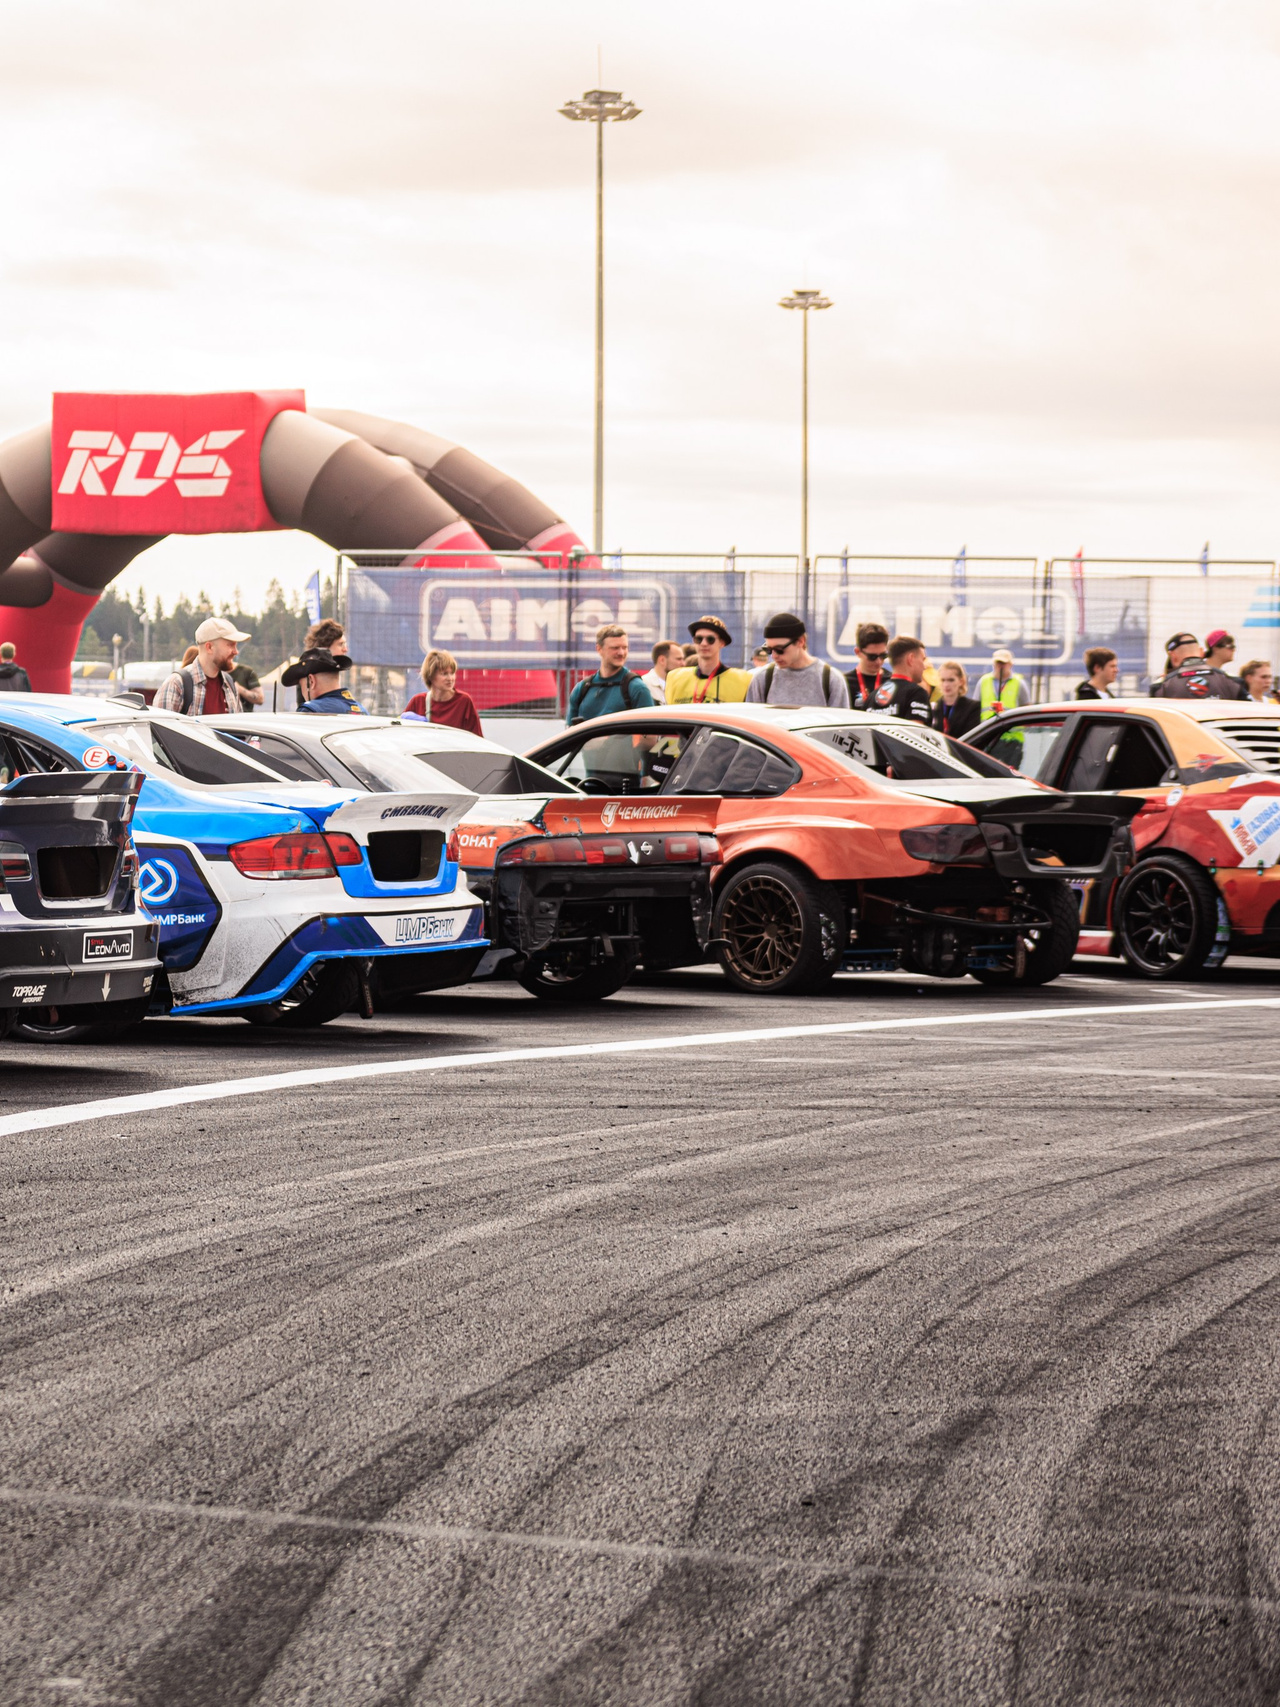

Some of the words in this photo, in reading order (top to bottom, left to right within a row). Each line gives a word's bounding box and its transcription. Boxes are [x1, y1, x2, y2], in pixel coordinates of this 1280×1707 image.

[57, 429, 246, 498] RDS
[618, 805, 682, 819] ЧЕМПИОНАТ
[458, 834, 497, 848] ОНАТ
[395, 916, 454, 943] ЦМРБанк
[12, 984, 47, 997] TOPRACE
